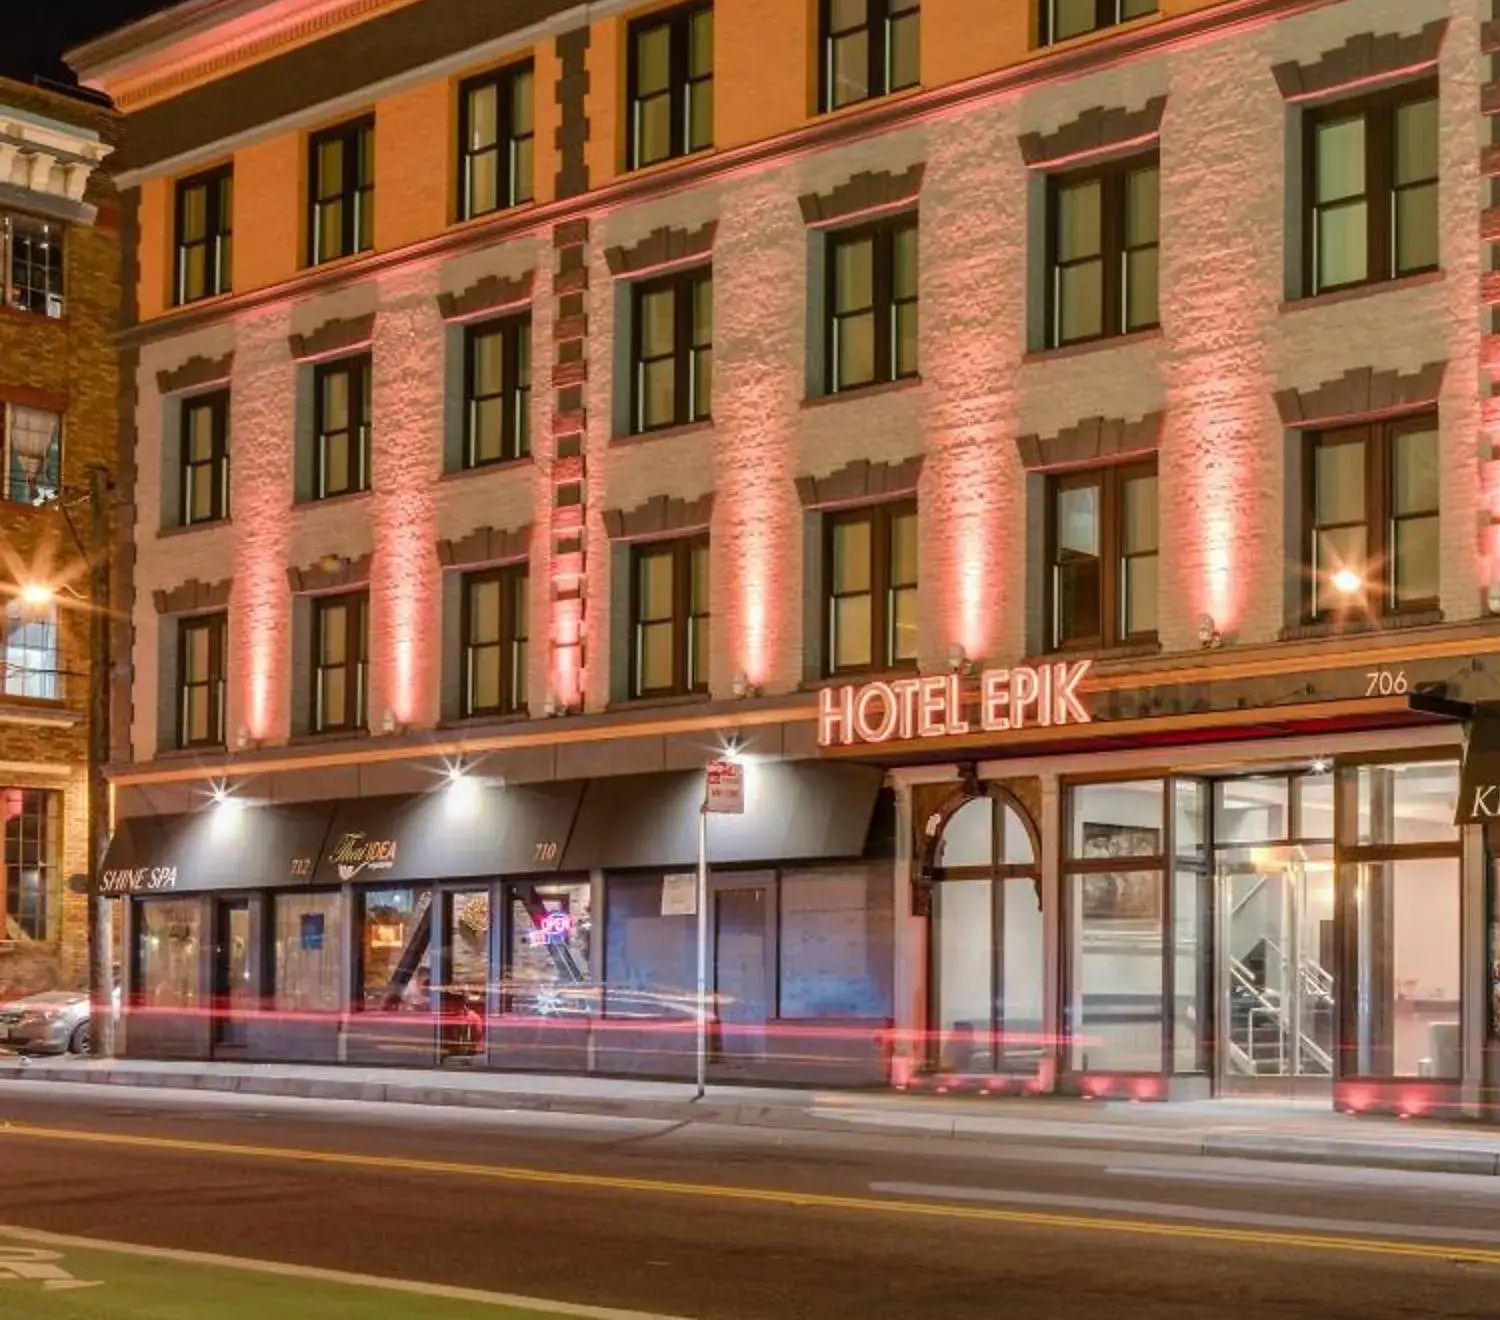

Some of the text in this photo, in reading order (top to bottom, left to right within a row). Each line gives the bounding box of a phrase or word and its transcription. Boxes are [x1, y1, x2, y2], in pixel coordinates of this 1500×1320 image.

[1365, 671, 1408, 697] 706
[818, 659, 1092, 746] HOTEL EPIK
[533, 842, 558, 862] 710
[100, 866, 177, 892] SHINE SPA
